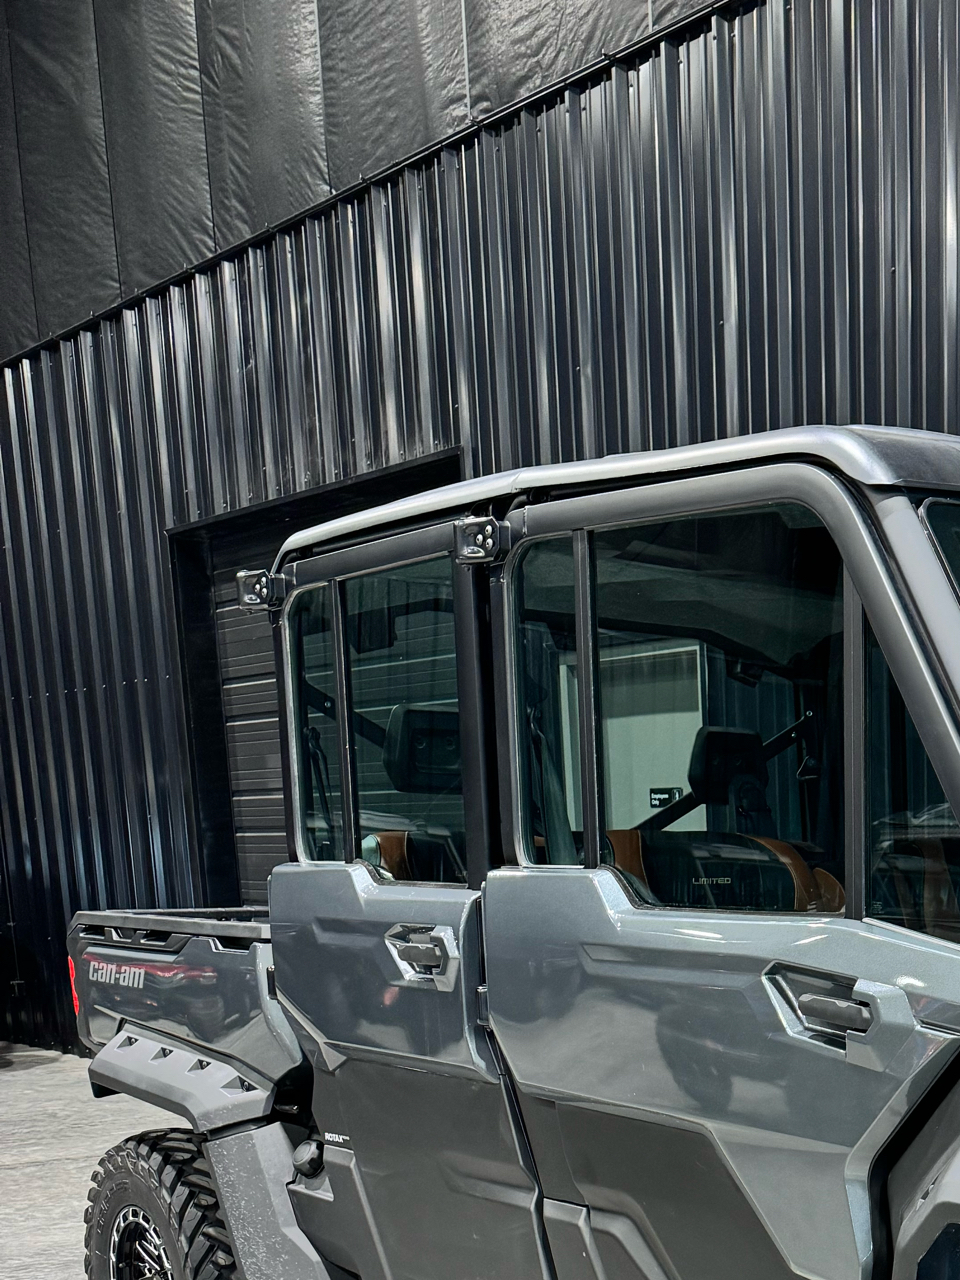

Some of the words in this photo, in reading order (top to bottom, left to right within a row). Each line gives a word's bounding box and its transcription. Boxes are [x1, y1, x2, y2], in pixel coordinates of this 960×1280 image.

[692, 877, 732, 885] LIMITED
[89, 961, 146, 989] can-am
[324, 1132, 344, 1143] ROTAX
